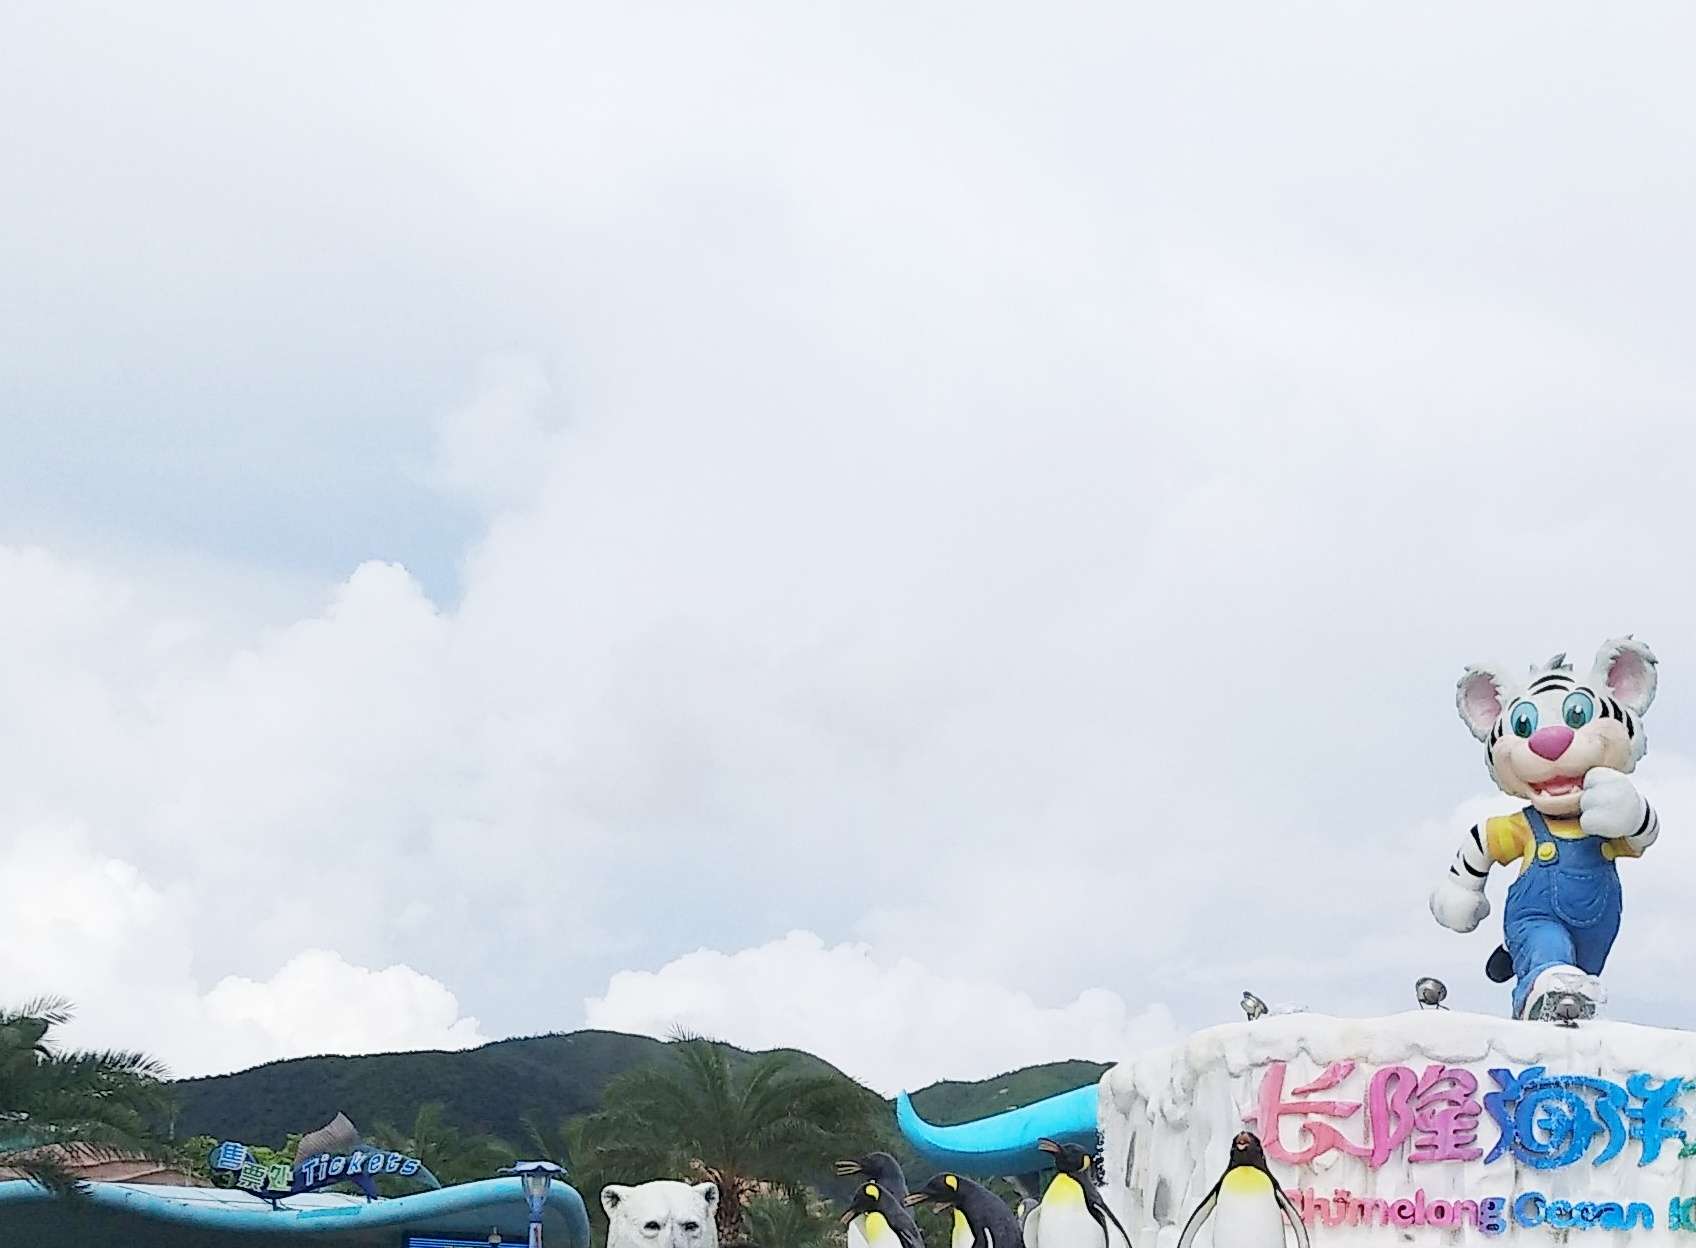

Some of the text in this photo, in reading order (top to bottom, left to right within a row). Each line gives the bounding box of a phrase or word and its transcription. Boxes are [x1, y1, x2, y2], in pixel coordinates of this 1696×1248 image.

[217, 1141, 293, 1192] 售票处
[301, 1151, 421, 1187] Tickets
[1513, 1191, 1655, 1231] Ocean
